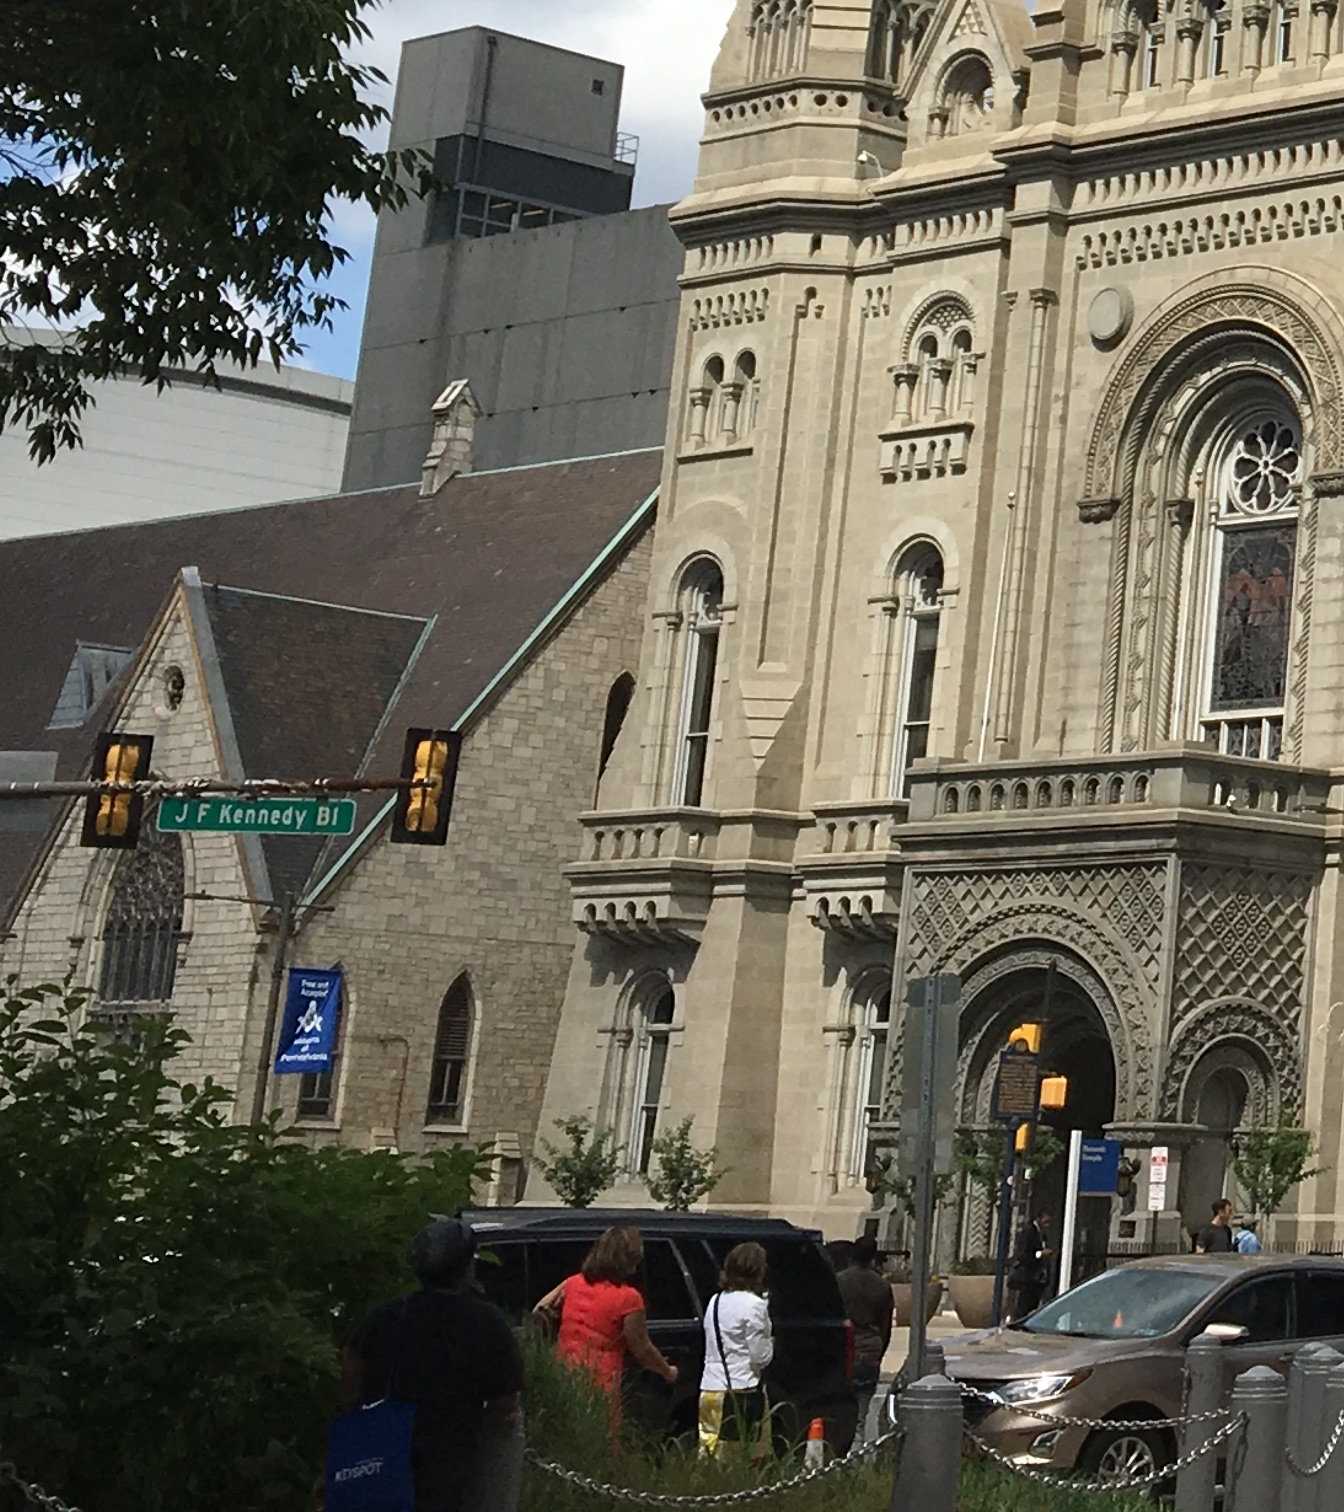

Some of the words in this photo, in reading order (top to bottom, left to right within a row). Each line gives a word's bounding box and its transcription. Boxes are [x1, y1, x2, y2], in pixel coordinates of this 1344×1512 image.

[175, 803, 189, 823] J
[197, 803, 211, 823] F
[219, 803, 307, 830] Kennedy
